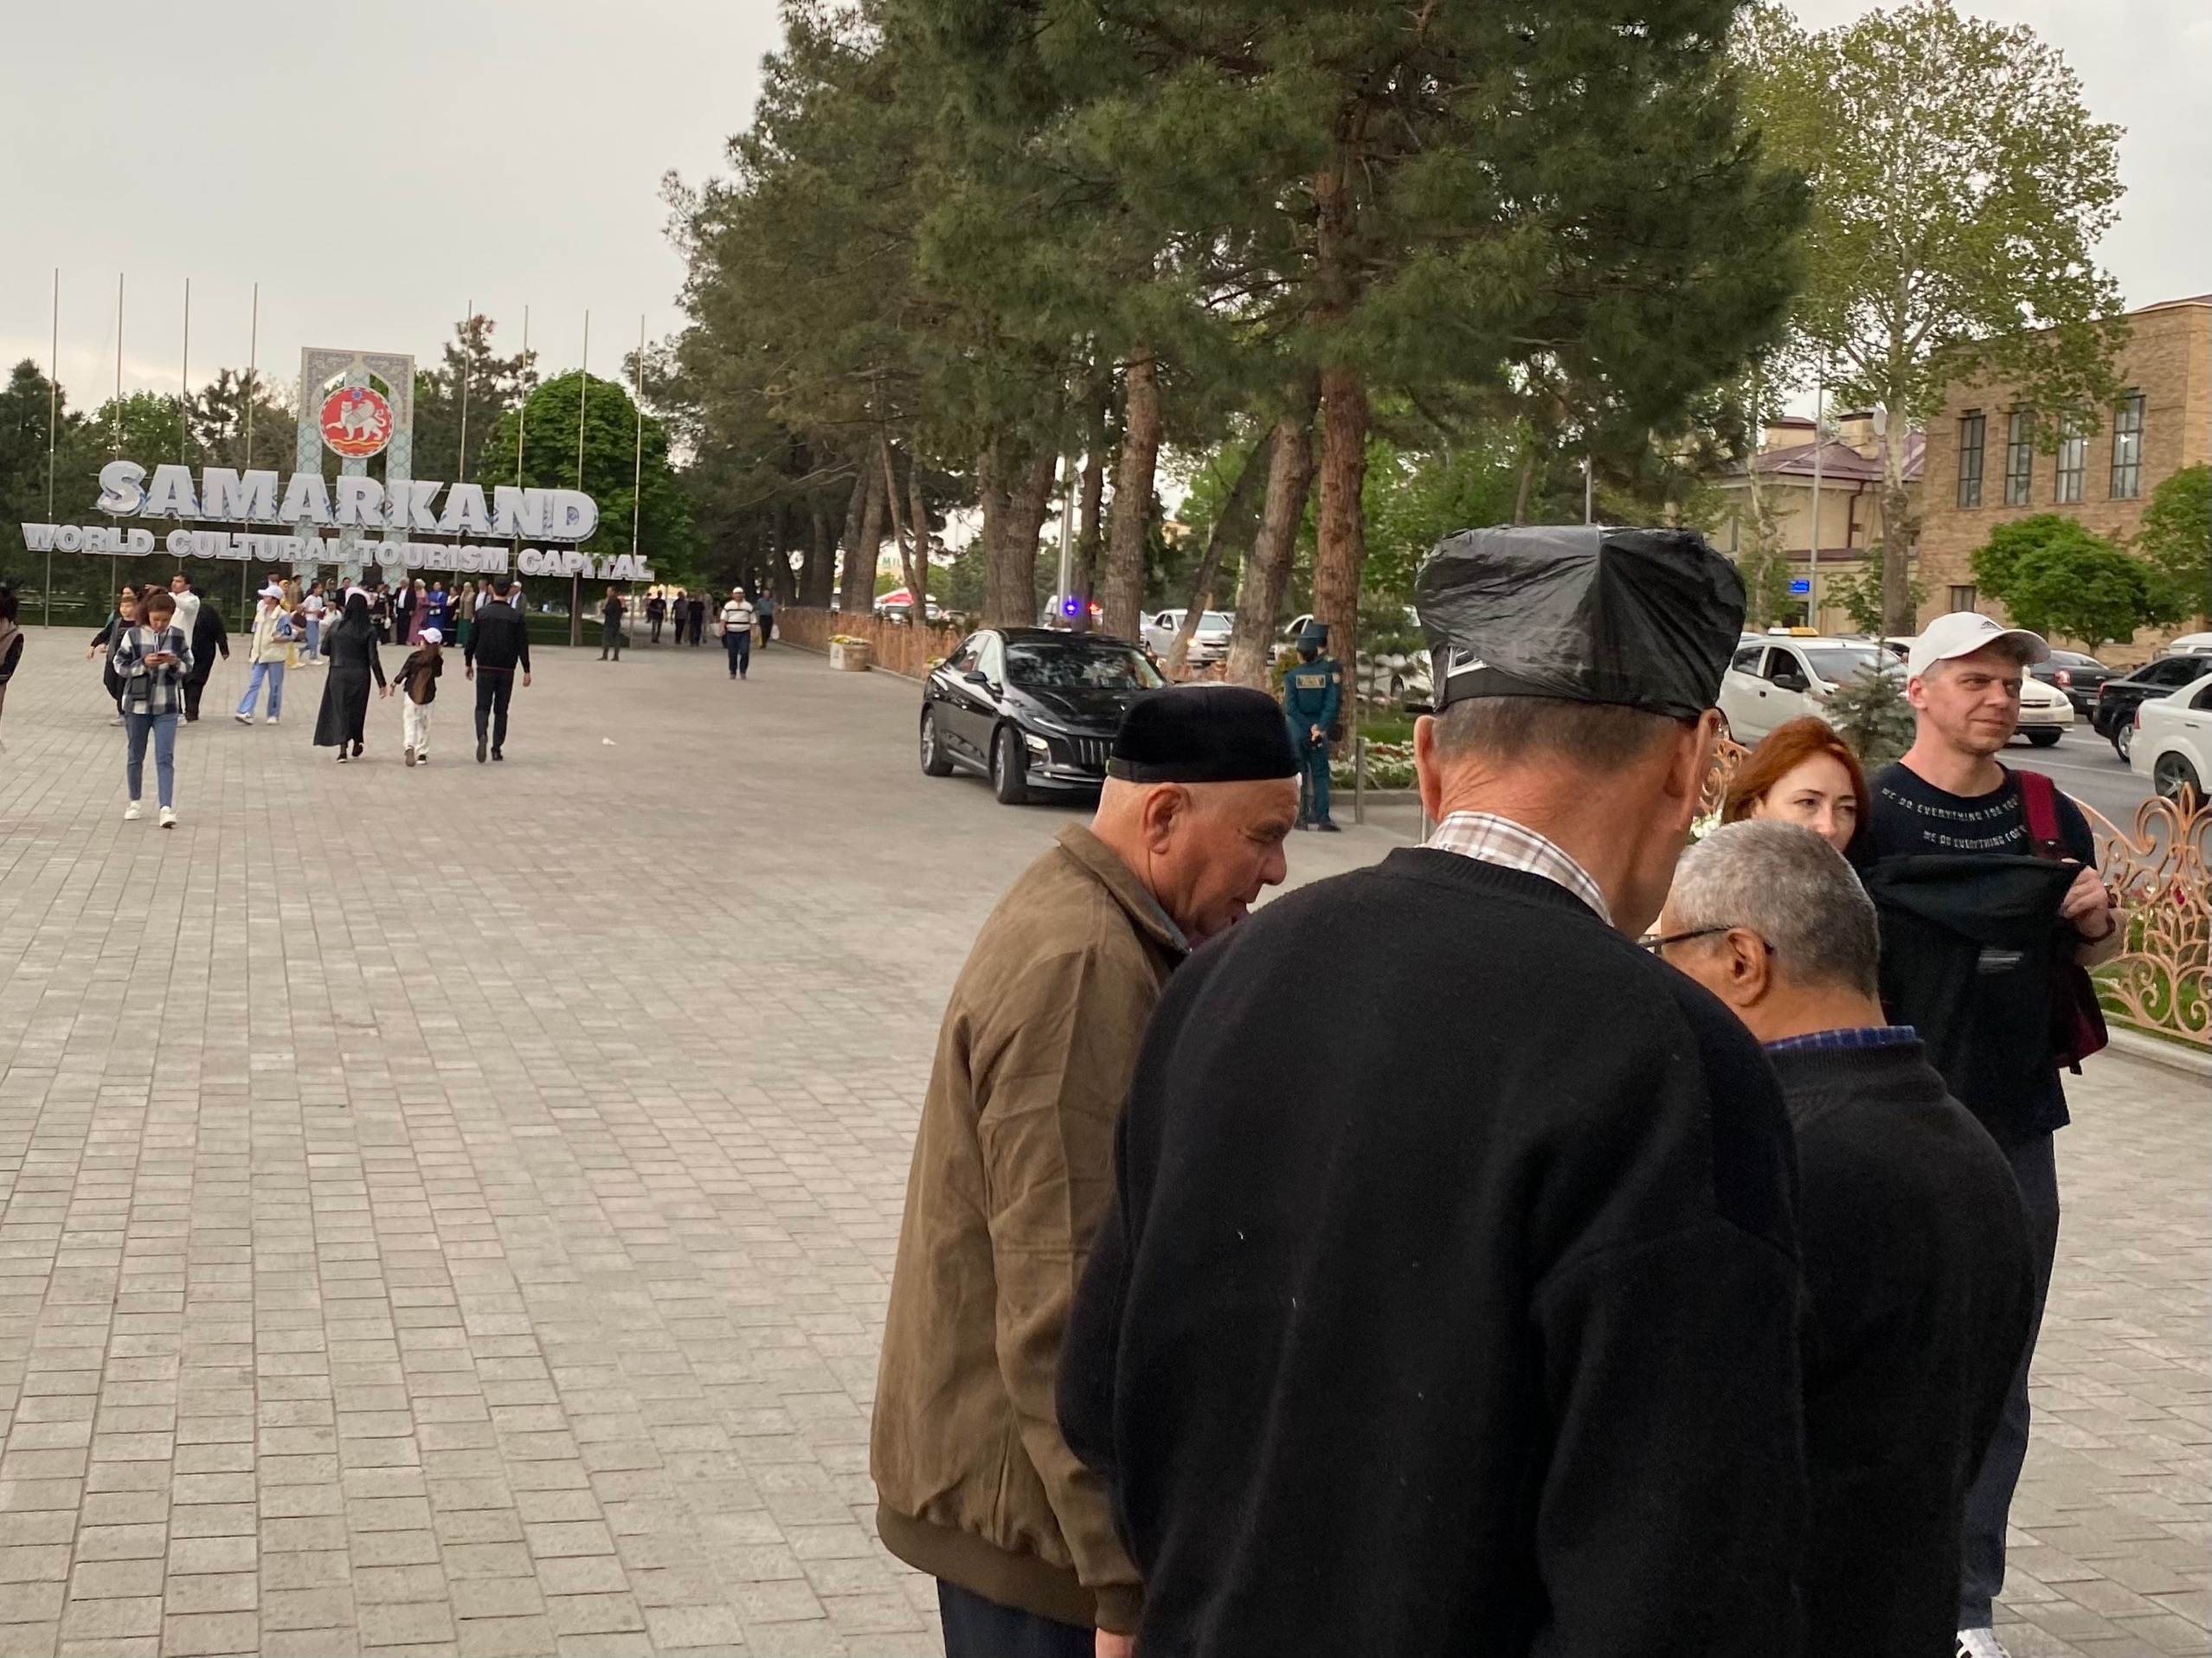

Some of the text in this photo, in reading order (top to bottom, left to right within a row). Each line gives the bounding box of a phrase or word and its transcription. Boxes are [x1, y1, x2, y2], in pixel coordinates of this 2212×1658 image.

[97, 460, 599, 543] SAMARKAND
[21, 523, 655, 582] WORLD CULTURAL TOURISM CAPITAL
